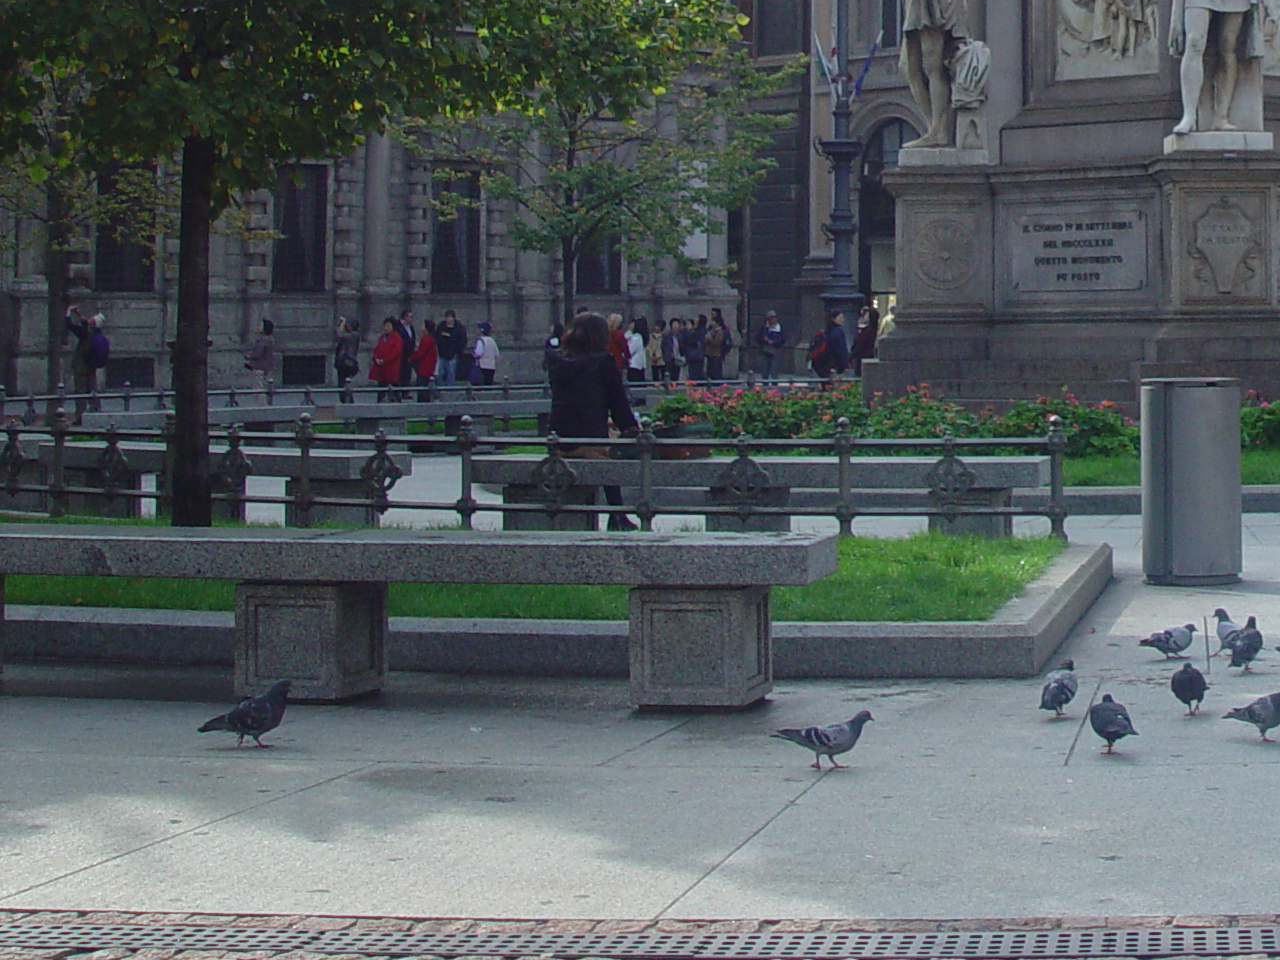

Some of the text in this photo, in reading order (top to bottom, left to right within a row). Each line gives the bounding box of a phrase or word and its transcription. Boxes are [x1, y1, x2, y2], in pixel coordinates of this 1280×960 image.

[1085, 221, 1134, 230] SETTEMBRE
[1034, 255, 1123, 267] QUESTO MONUMENTO
[1071, 272, 1101, 281] POSTO
